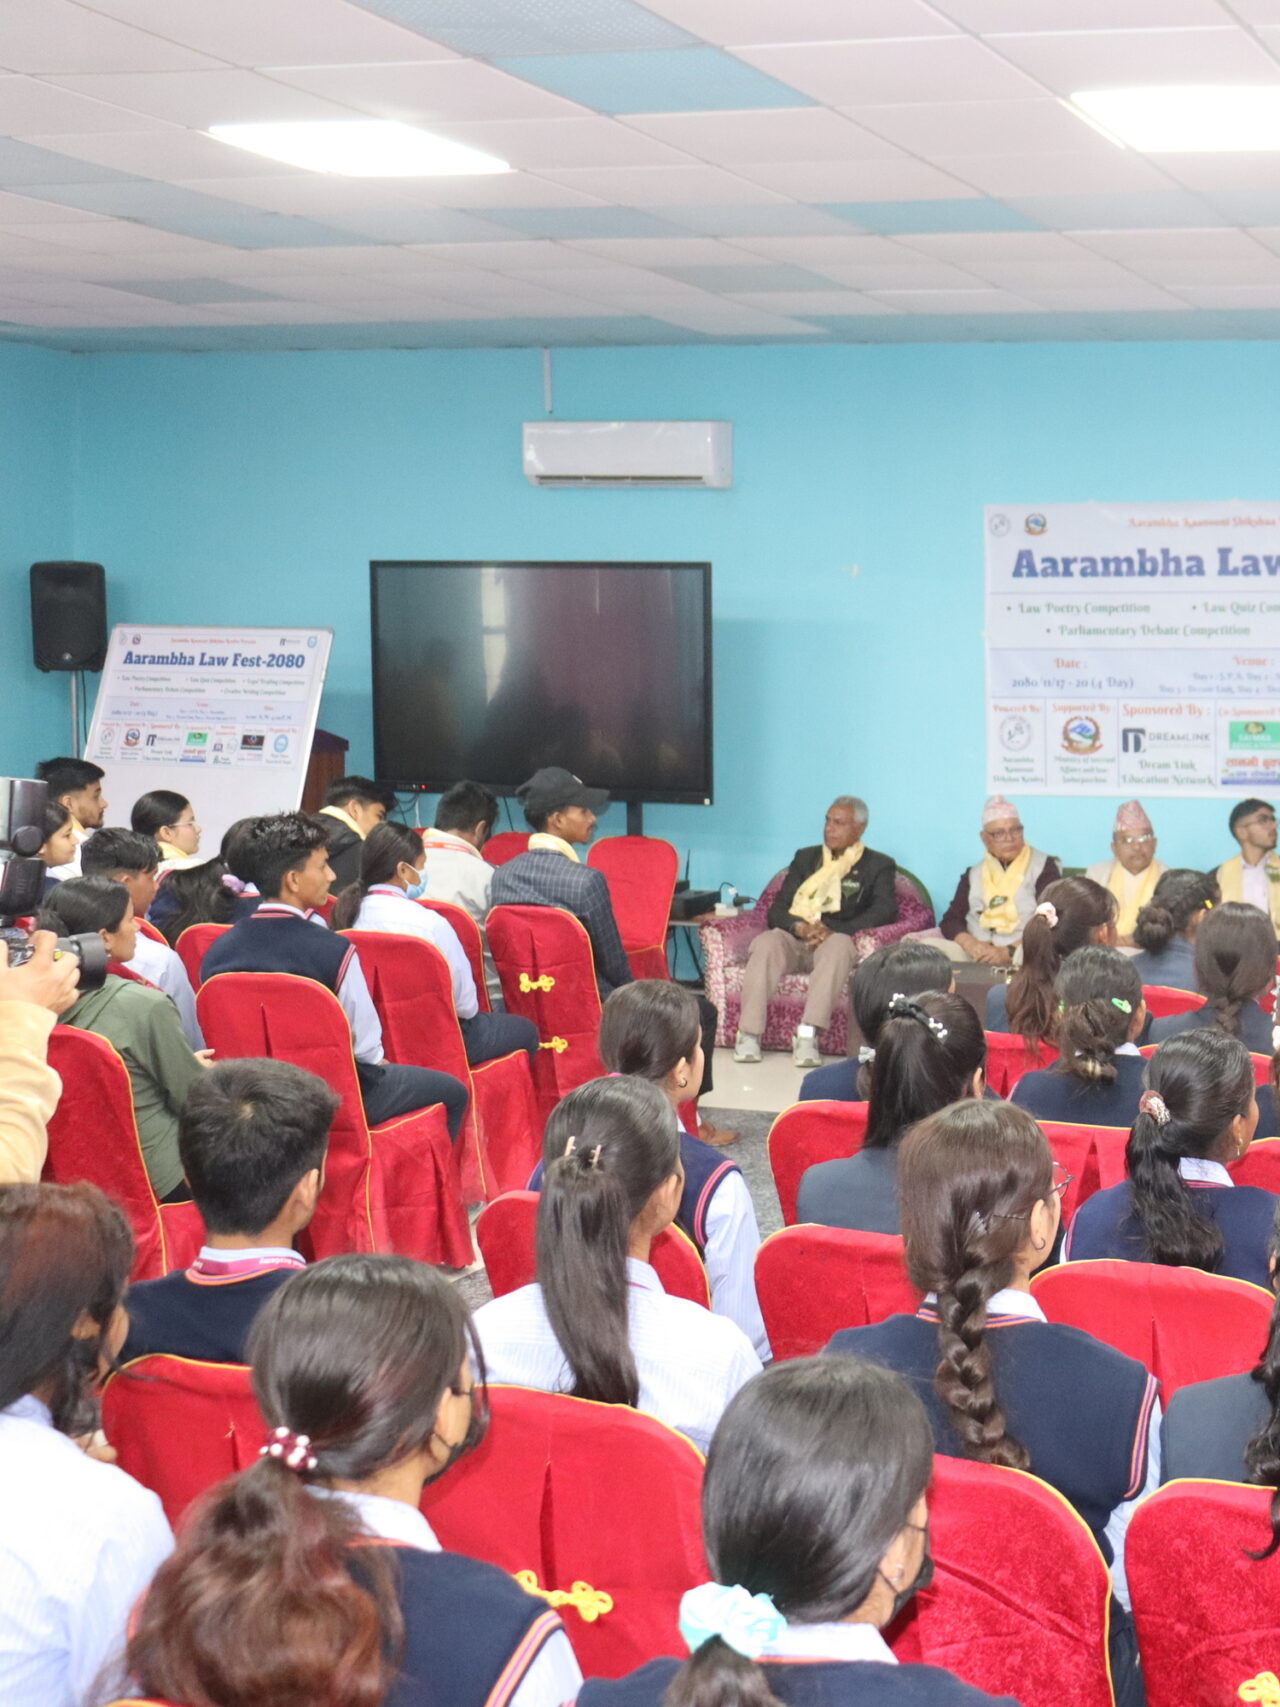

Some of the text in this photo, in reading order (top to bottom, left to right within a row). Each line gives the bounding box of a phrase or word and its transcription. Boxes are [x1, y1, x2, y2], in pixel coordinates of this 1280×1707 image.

[1012, 547, 1206, 578] Aarambha
[1019, 602, 1151, 616] Law Poetry Competition
[1203, 601, 1226, 613] Law
[1230, 601, 1256, 614] Quiz
[1058, 624, 1251, 637] Parliamentary Debate Competition
[123, 650, 305, 669] Aarambha Law Fest-2080
[1054, 657, 1081, 669] Date
[1233, 655, 1267, 667] Venue
[1051, 703, 1096, 715] Supported
[1122, 703, 1183, 717] Sponsored
[1186, 703, 1204, 717] By
[1148, 732, 1210, 742] DREAMLINK
[1138, 759, 1197, 771] Dream Link
[1121, 774, 1170, 785] Education
[1172, 774, 1216, 787] Network
